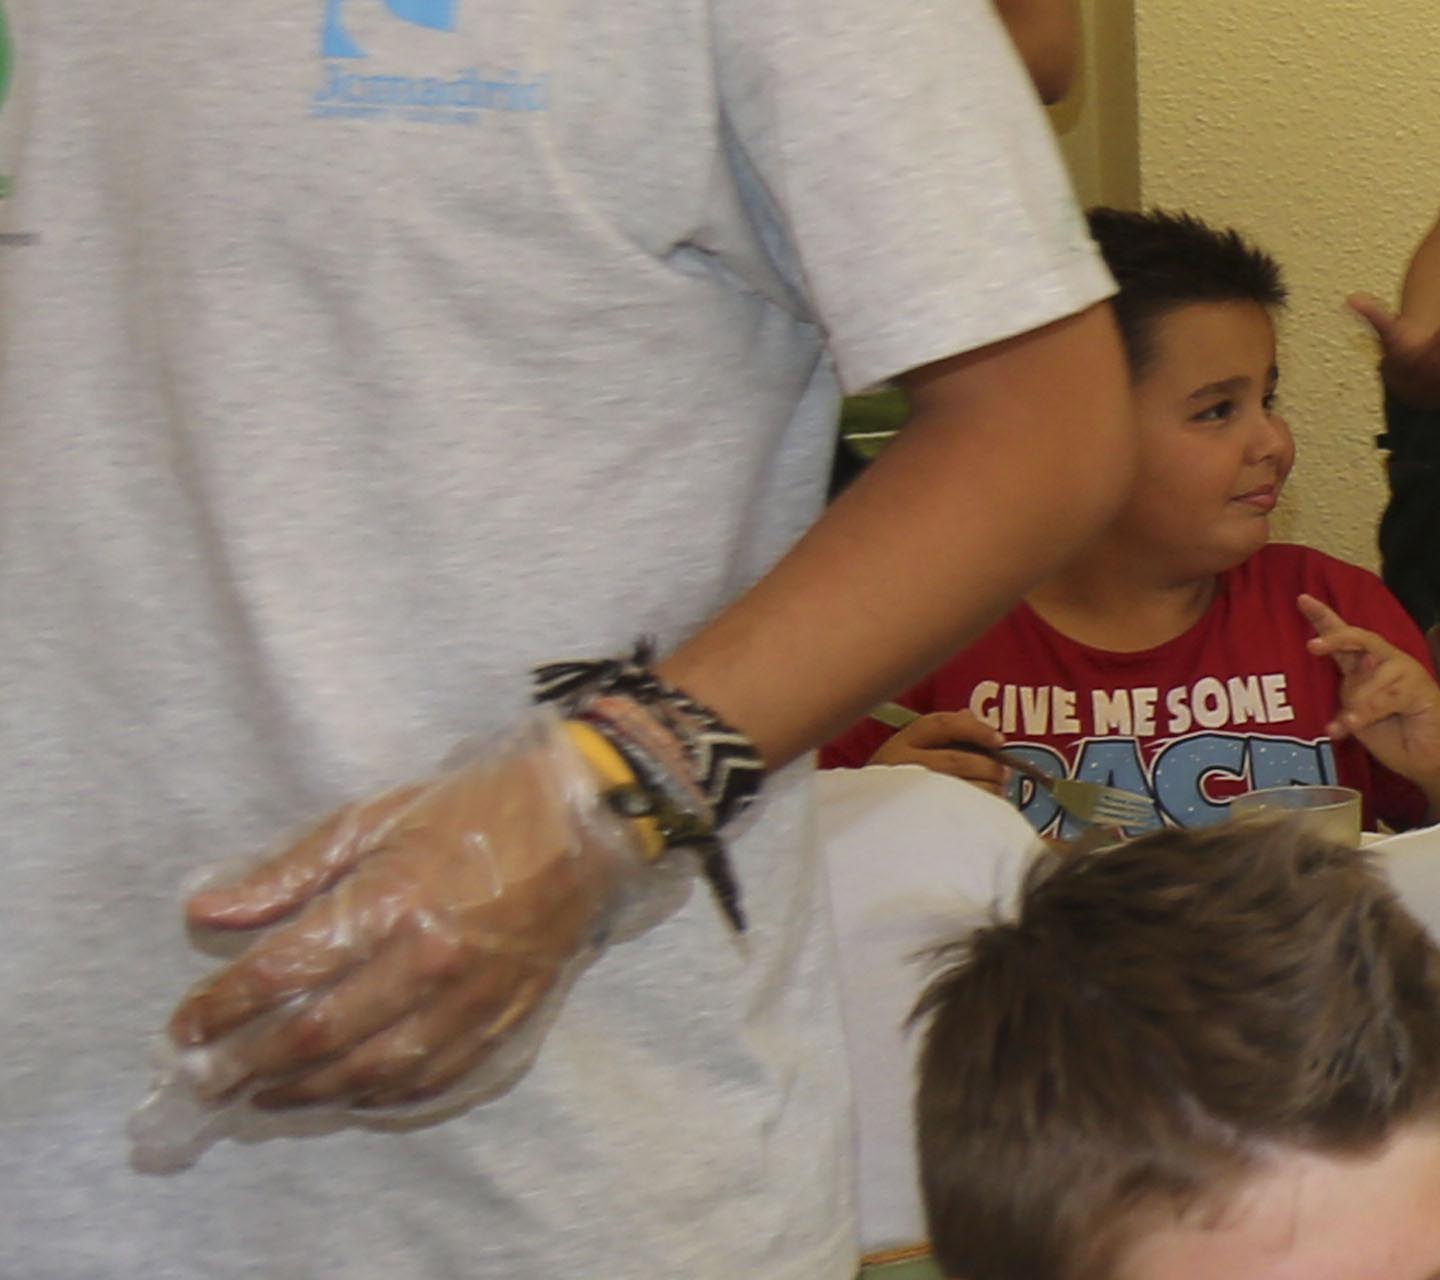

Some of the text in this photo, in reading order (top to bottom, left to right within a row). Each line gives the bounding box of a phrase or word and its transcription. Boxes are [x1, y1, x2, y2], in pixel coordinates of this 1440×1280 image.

[967, 672, 1295, 738] GIVE ME SOME
